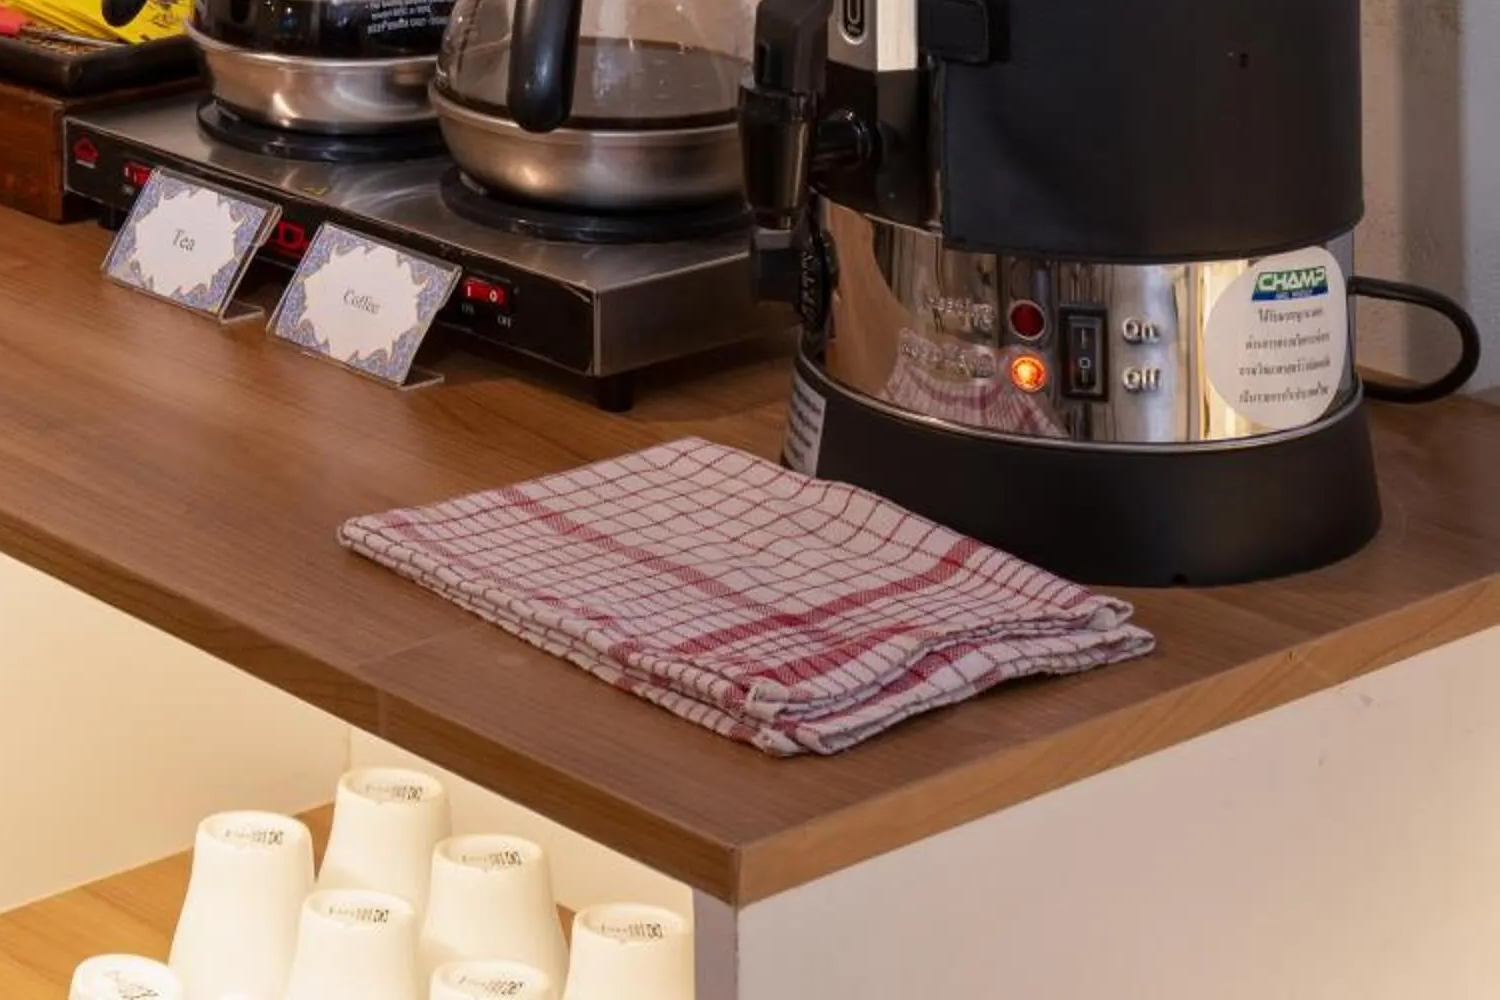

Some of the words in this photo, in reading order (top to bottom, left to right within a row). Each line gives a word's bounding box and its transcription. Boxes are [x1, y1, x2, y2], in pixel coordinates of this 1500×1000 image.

[172, 228, 196, 251] Tea
[1258, 267, 1326, 292] CHAMP
[343, 289, 380, 315] Coffee
[1123, 317, 1160, 343] On
[1123, 368, 1164, 392] Off
